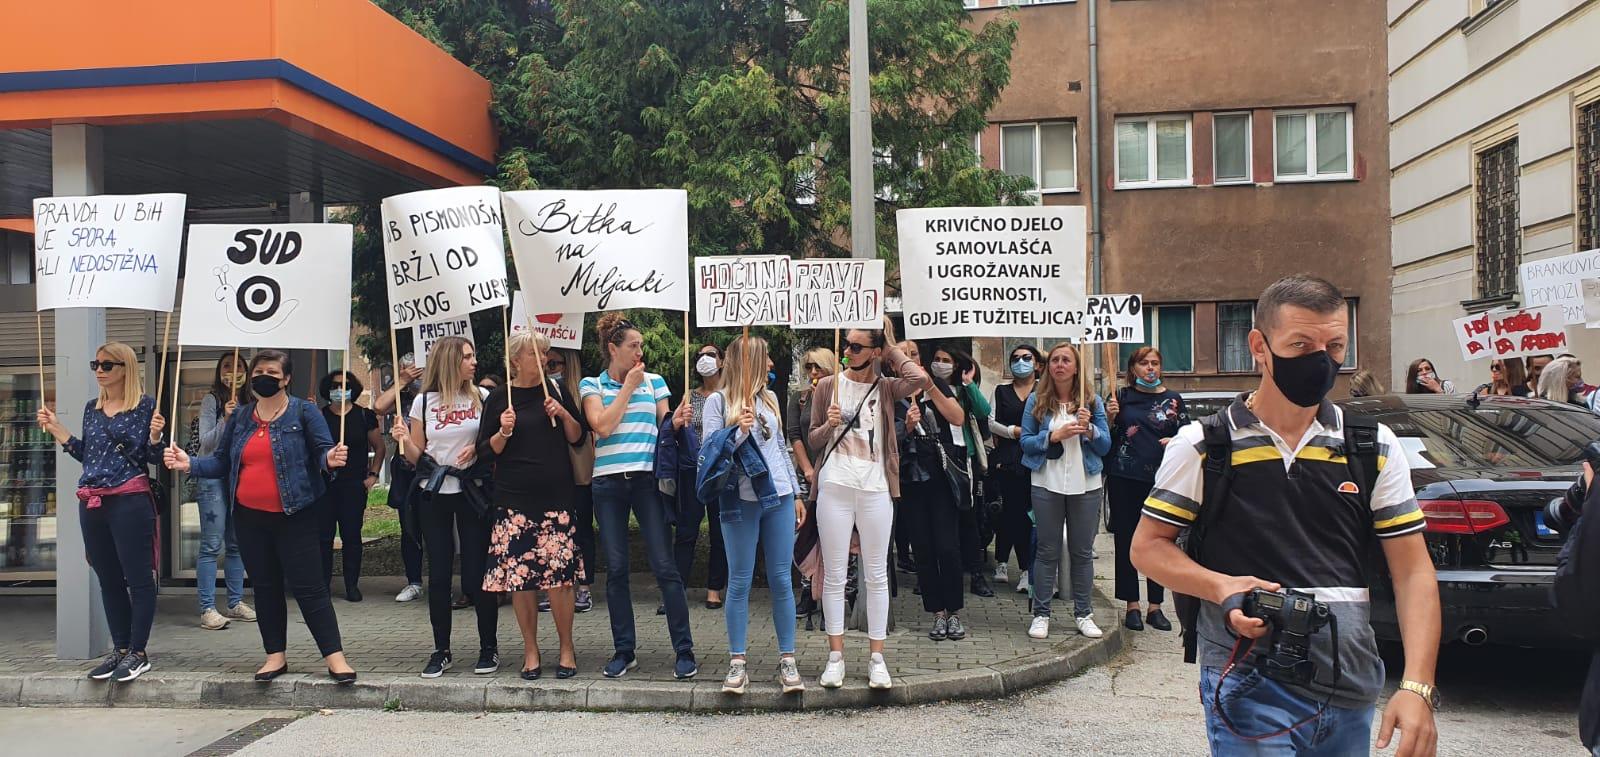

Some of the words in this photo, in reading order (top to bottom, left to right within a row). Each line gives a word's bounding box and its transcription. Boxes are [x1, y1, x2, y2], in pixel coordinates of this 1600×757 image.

[37, 203, 98, 225] PRAVDA
[114, 203, 126, 221] U
[409, 200, 501, 237] PISMONOŠA
[519, 199, 655, 236] Bitka
[925, 216, 1006, 233] KRIVIČNO
[1011, 217, 1063, 232] DJELO
[37, 229, 56, 250] JE
[226, 228, 303, 265] SUD
[936, 239, 1052, 255] SAMOVLAŠĆA
[37, 256, 60, 276] ALI
[69, 248, 158, 274] NEDOSTIŽNA
[446, 246, 479, 270] OD
[556, 242, 600, 262] na
[701, 258, 758, 290] HOĆU
[762, 257, 792, 289] NA
[796, 262, 865, 290] PRAVO
[928, 265, 933, 279] I
[937, 262, 1060, 278] UGROŽAVANJE
[561, 261, 674, 310] Miljacki
[941, 287, 1047, 304] SIGURNOSTI,
[1531, 282, 1579, 304] POMOZI
[795, 292, 823, 324] NA
[829, 290, 878, 323] RAD
[910, 312, 948, 326] GDJE
[952, 311, 969, 325] JE
[973, 308, 1083, 326] TUŽITELJICA?
[419, 320, 467, 339] PRISTUP
[1093, 316, 1112, 326] NA
[1494, 338, 1515, 355] DA
